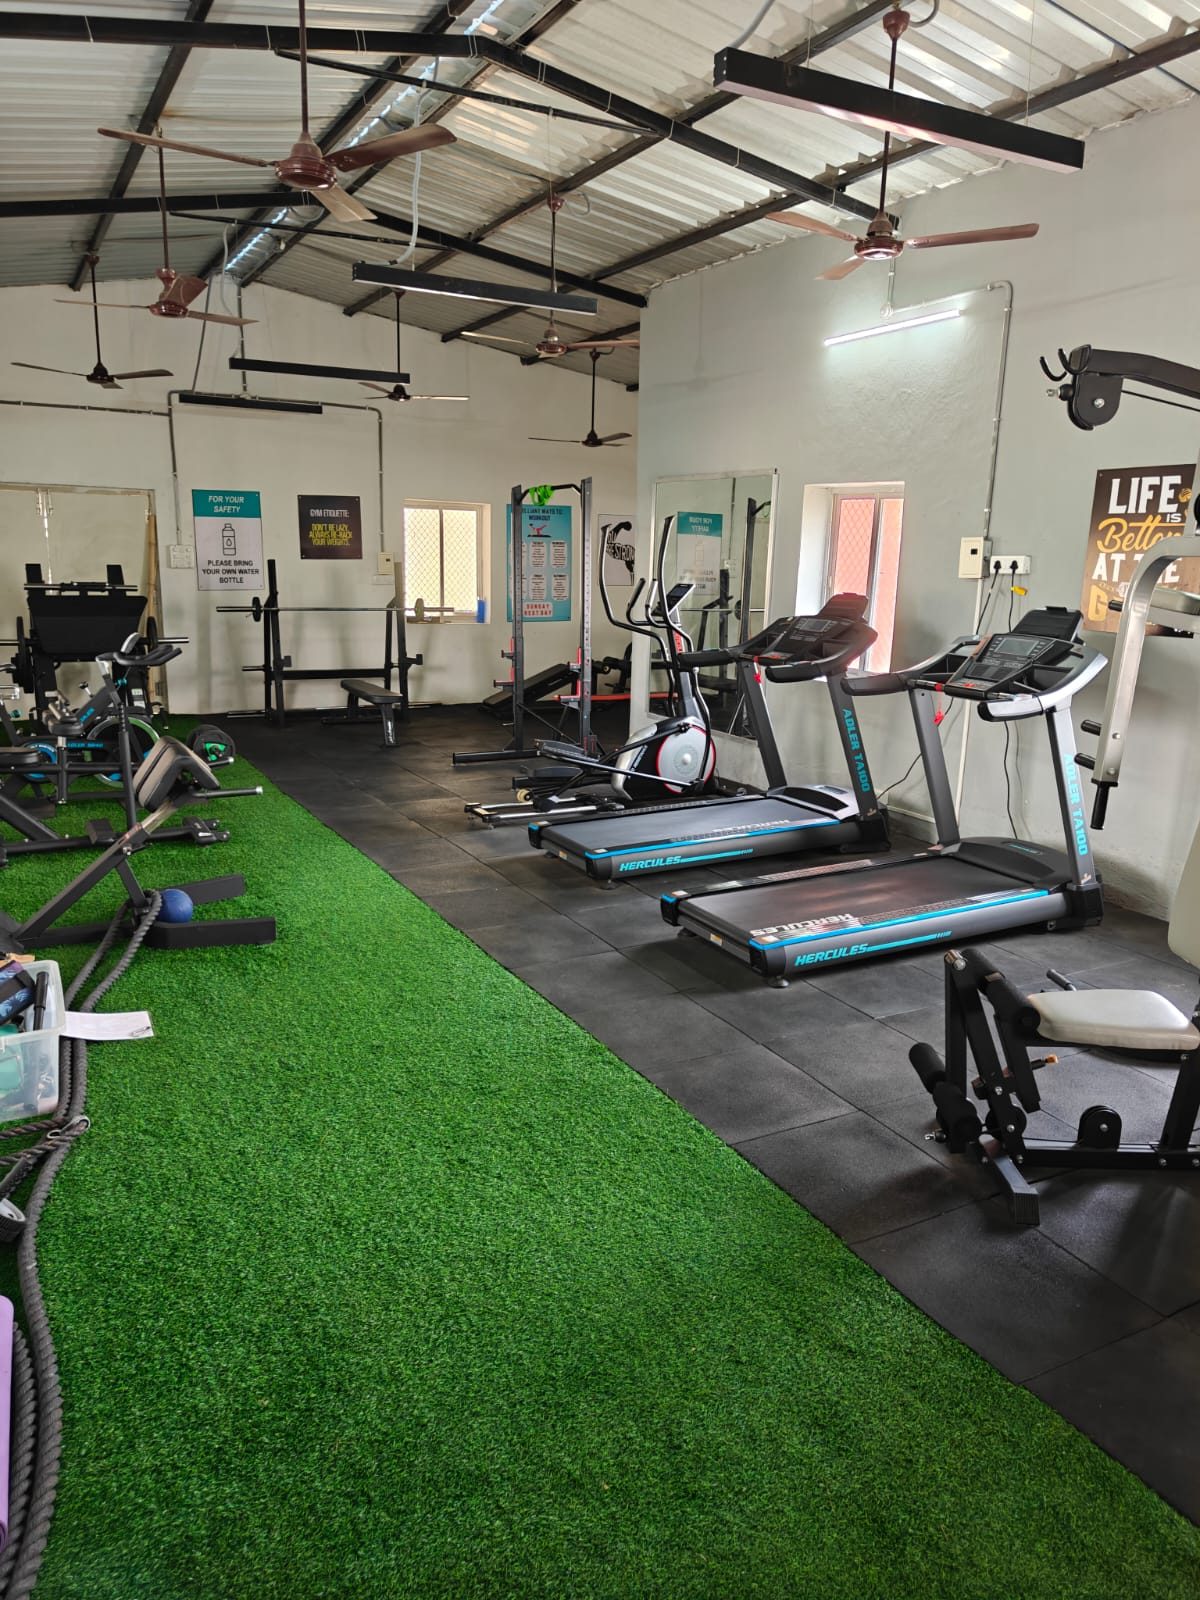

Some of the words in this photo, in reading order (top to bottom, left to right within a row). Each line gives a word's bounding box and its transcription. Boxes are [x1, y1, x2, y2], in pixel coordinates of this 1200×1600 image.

[208, 495, 224, 503] FOR
[225, 496, 245, 504] YOUR
[1107, 474, 1182, 514] LIFE
[213, 505, 240, 513] SAFETY
[310, 508, 323, 517] GYM
[207, 559, 232, 567] PLEASE
[1092, 552, 1126, 582] AT
[219, 576, 244, 584] BOTTLE
[842, 707, 860, 751] ADLER
[853, 751, 871, 794] TA100
[1063, 753, 1081, 804] ADLER
[1072, 806, 1090, 856] TA100
[619, 855, 683, 873] HERCULES
[750, 913, 856, 938] HERCULES
[794, 943, 870, 968] HERCULES
